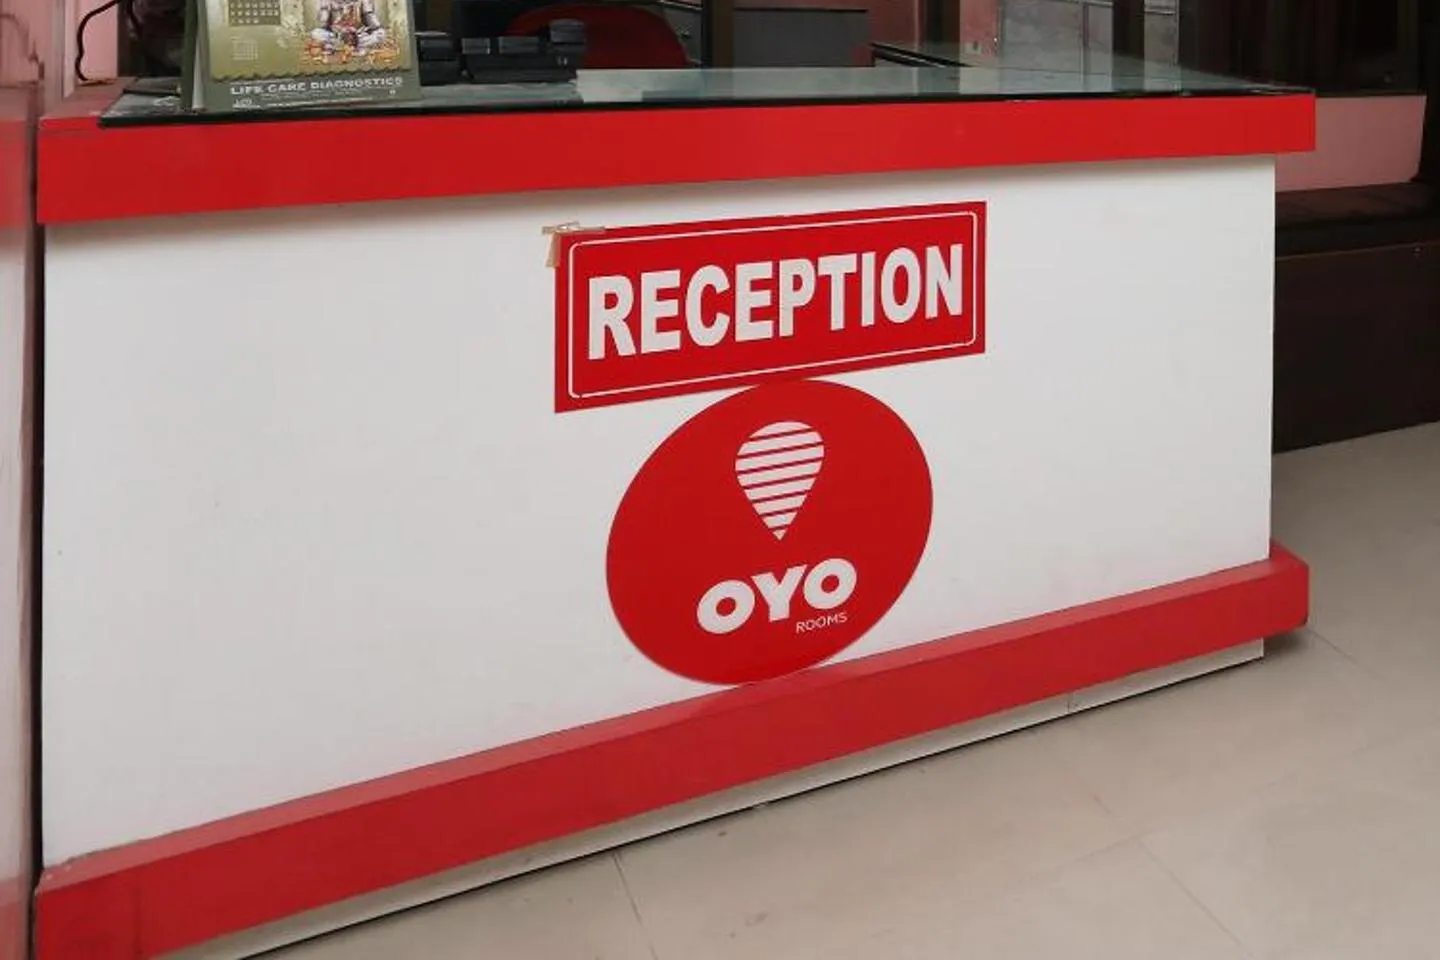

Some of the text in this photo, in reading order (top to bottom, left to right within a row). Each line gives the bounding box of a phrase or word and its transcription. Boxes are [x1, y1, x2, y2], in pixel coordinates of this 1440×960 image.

[230, 85, 264, 96] LIFE
[267, 83, 307, 93] CARE
[310, 76, 404, 91] DIAGNOSTICS
[588, 243, 964, 361] RECEPTION
[696, 557, 858, 635] OYO
[795, 611, 848, 634] ROOMS
